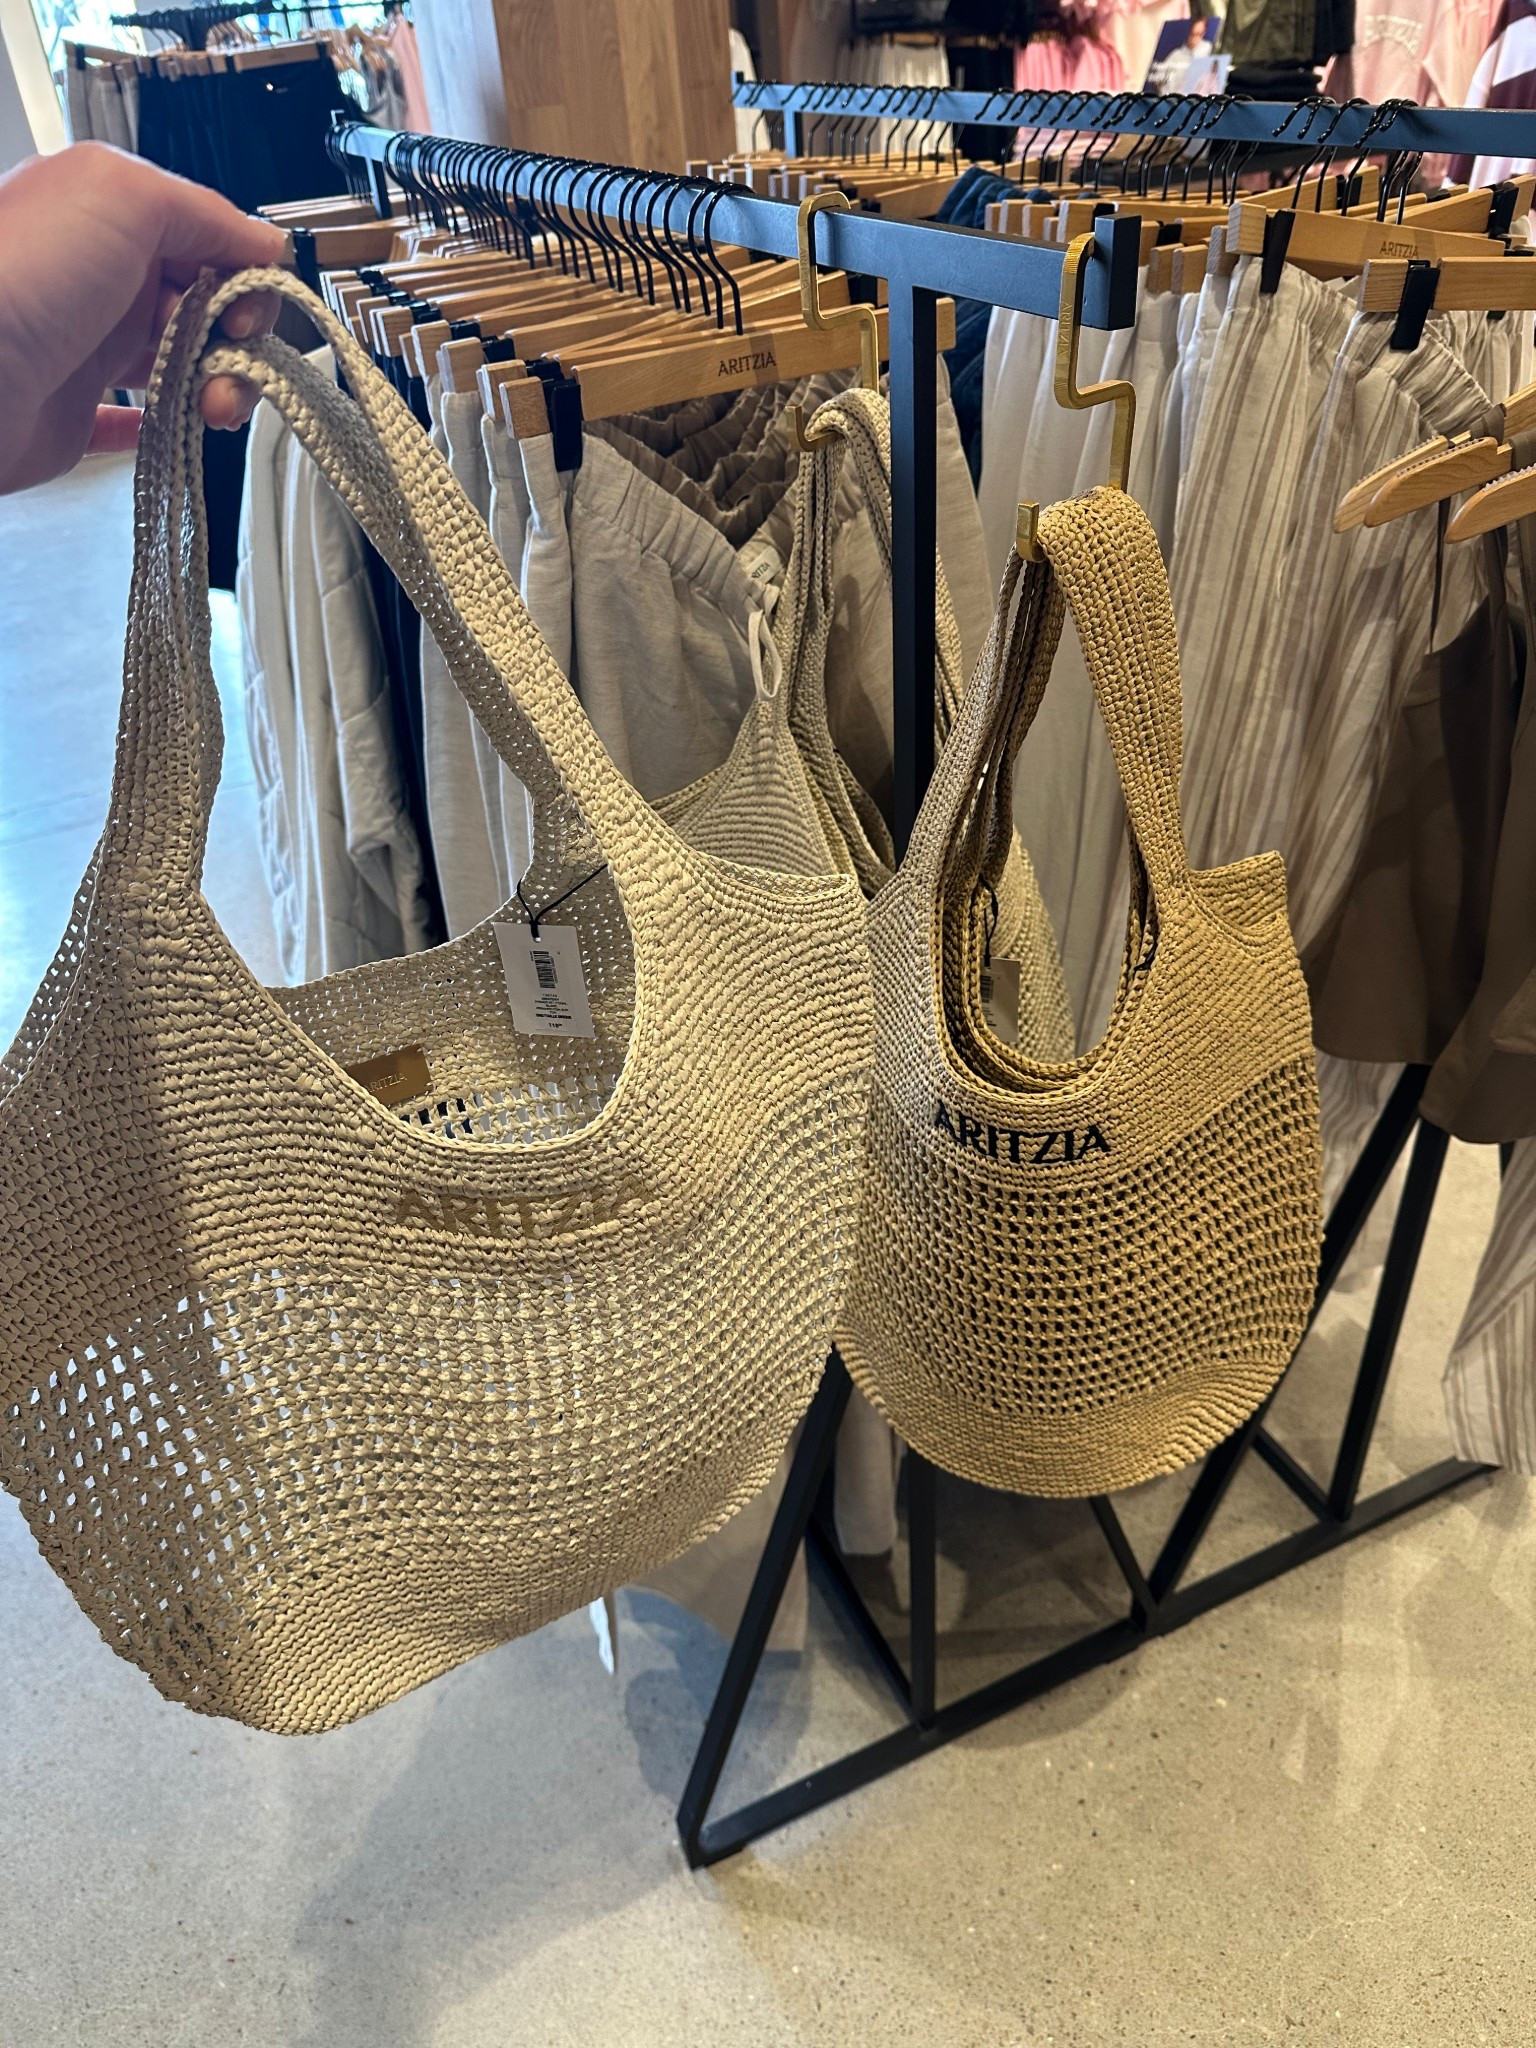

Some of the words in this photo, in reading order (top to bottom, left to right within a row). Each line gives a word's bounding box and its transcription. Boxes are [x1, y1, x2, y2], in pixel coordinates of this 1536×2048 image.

[1380, 240, 1419, 258] ARITZIA
[717, 351, 777, 377] ARITZIA
[750, 562, 771, 579] RITZIA
[934, 1099, 1111, 1165] ARITZIA
[396, 1176, 653, 1238] ARITZIA
